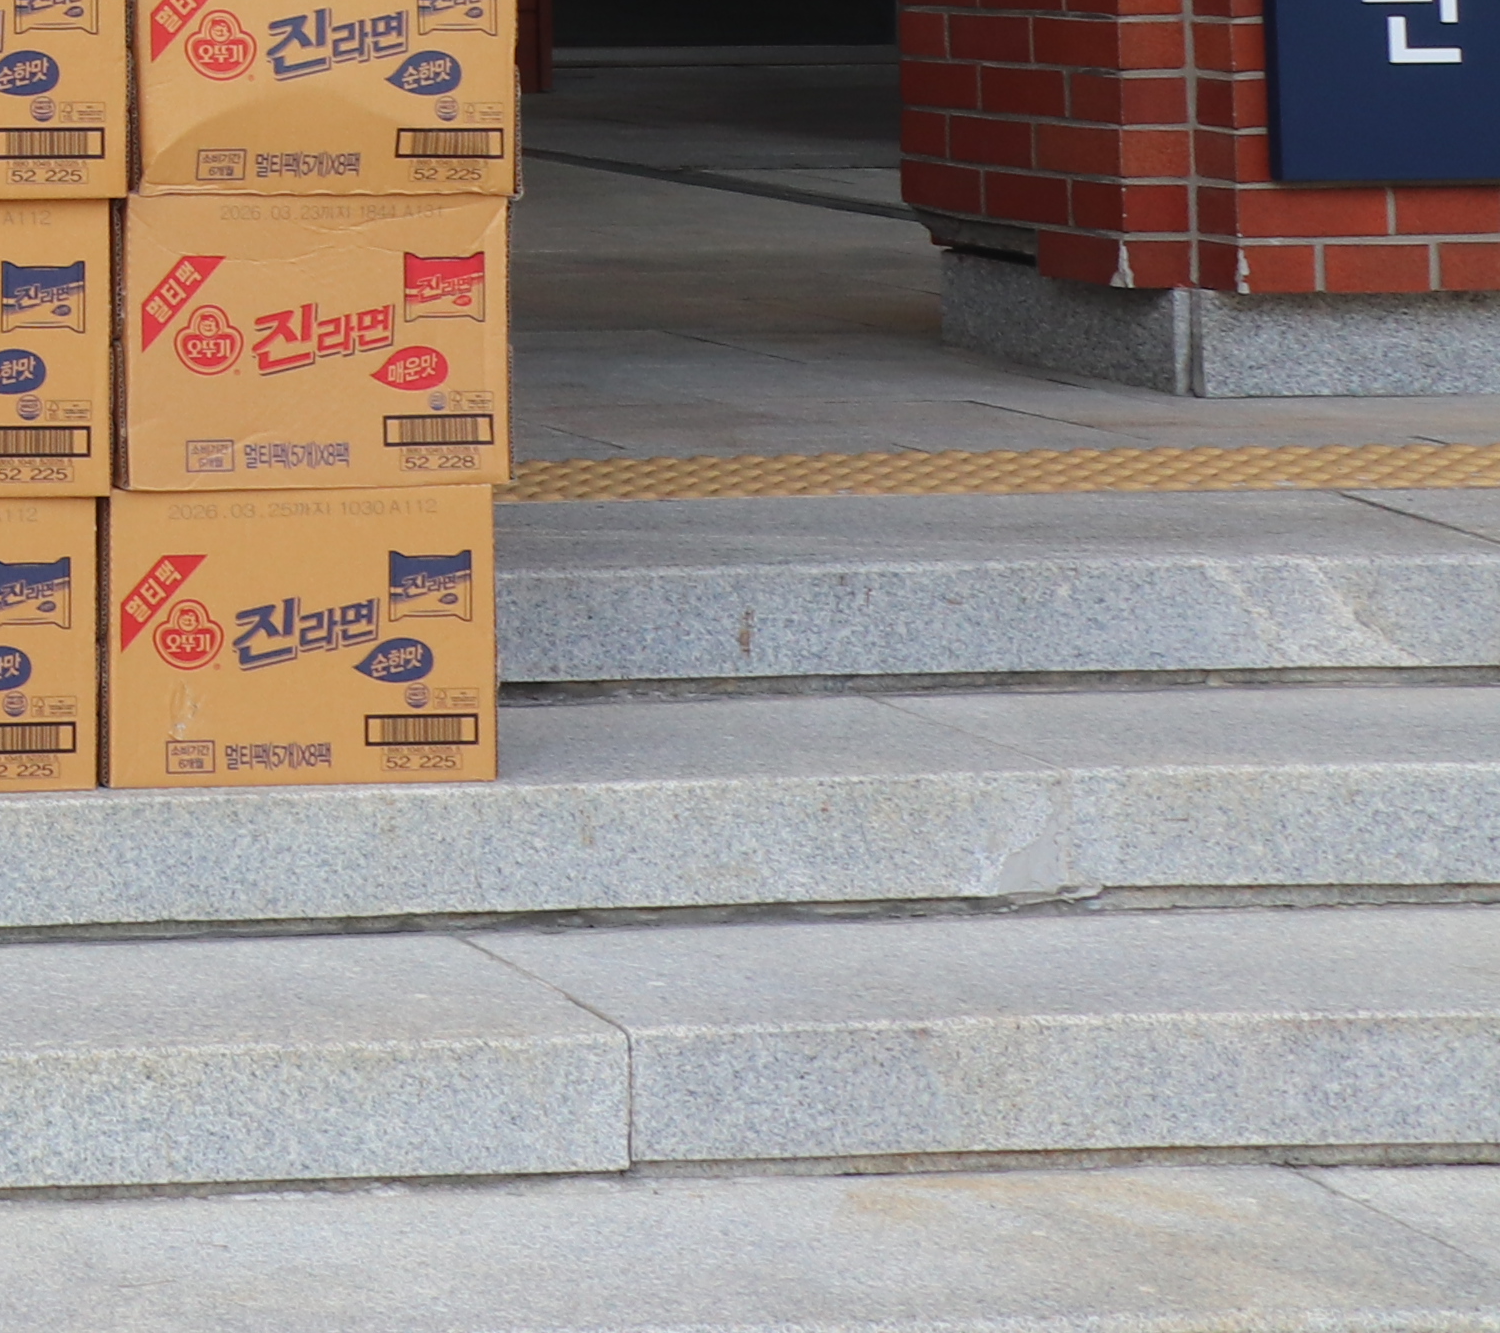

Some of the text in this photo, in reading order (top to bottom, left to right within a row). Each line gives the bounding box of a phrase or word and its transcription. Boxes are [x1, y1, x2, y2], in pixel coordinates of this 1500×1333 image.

[262, 7, 409, 81] 진라면
[250, 298, 398, 374] 진라면
[124, 560, 182, 622] 멀티팩
[166, 636, 212, 653] 오뚜기
[232, 594, 381, 671] 진라면
[369, 645, 426, 677] 순한맛
[418, 755, 455, 769] 225
